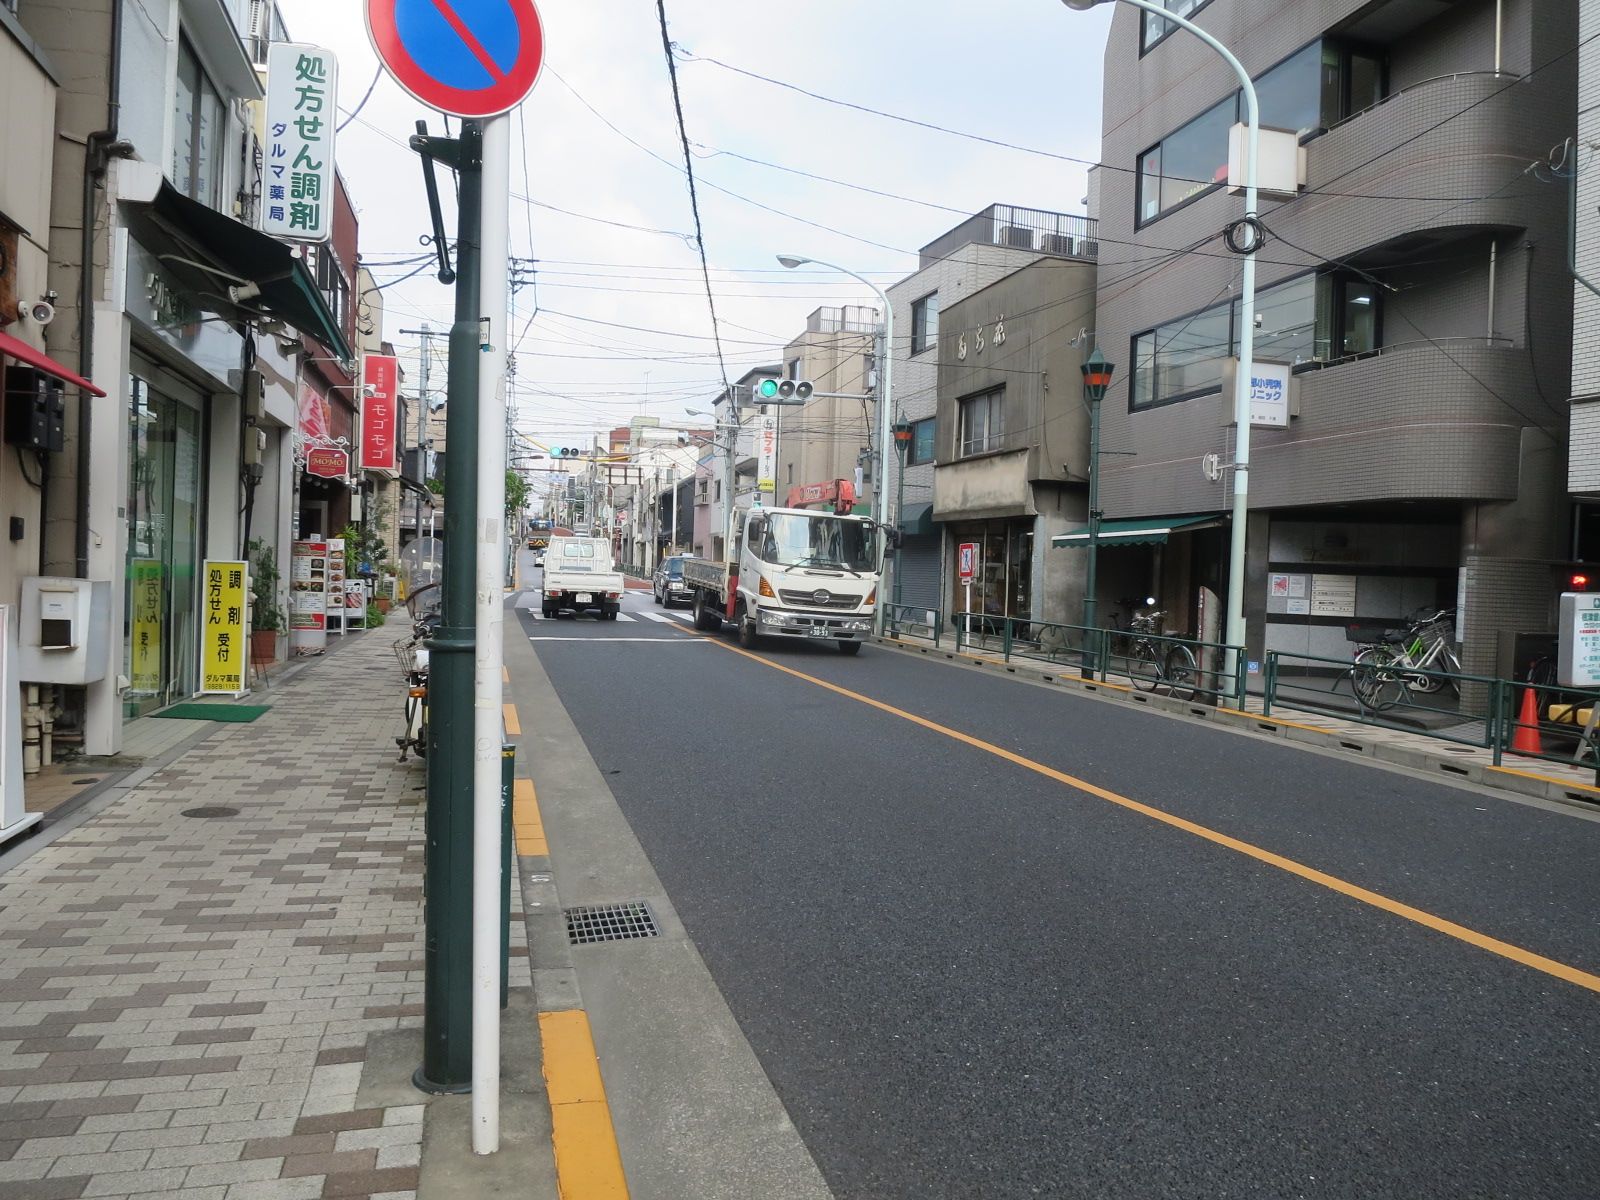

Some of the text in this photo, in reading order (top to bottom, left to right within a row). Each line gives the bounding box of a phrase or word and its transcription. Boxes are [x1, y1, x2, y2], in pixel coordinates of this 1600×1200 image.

[289, 53, 326, 231] 処方せん調剤
[268, 122, 287, 222] ダルマ薬局
[209, 569, 222, 625] 処方せん
[228, 570, 241, 625] 調剤
[217, 632, 230, 663] 受付
[206, 674, 241, 683] ダルマ薬局
